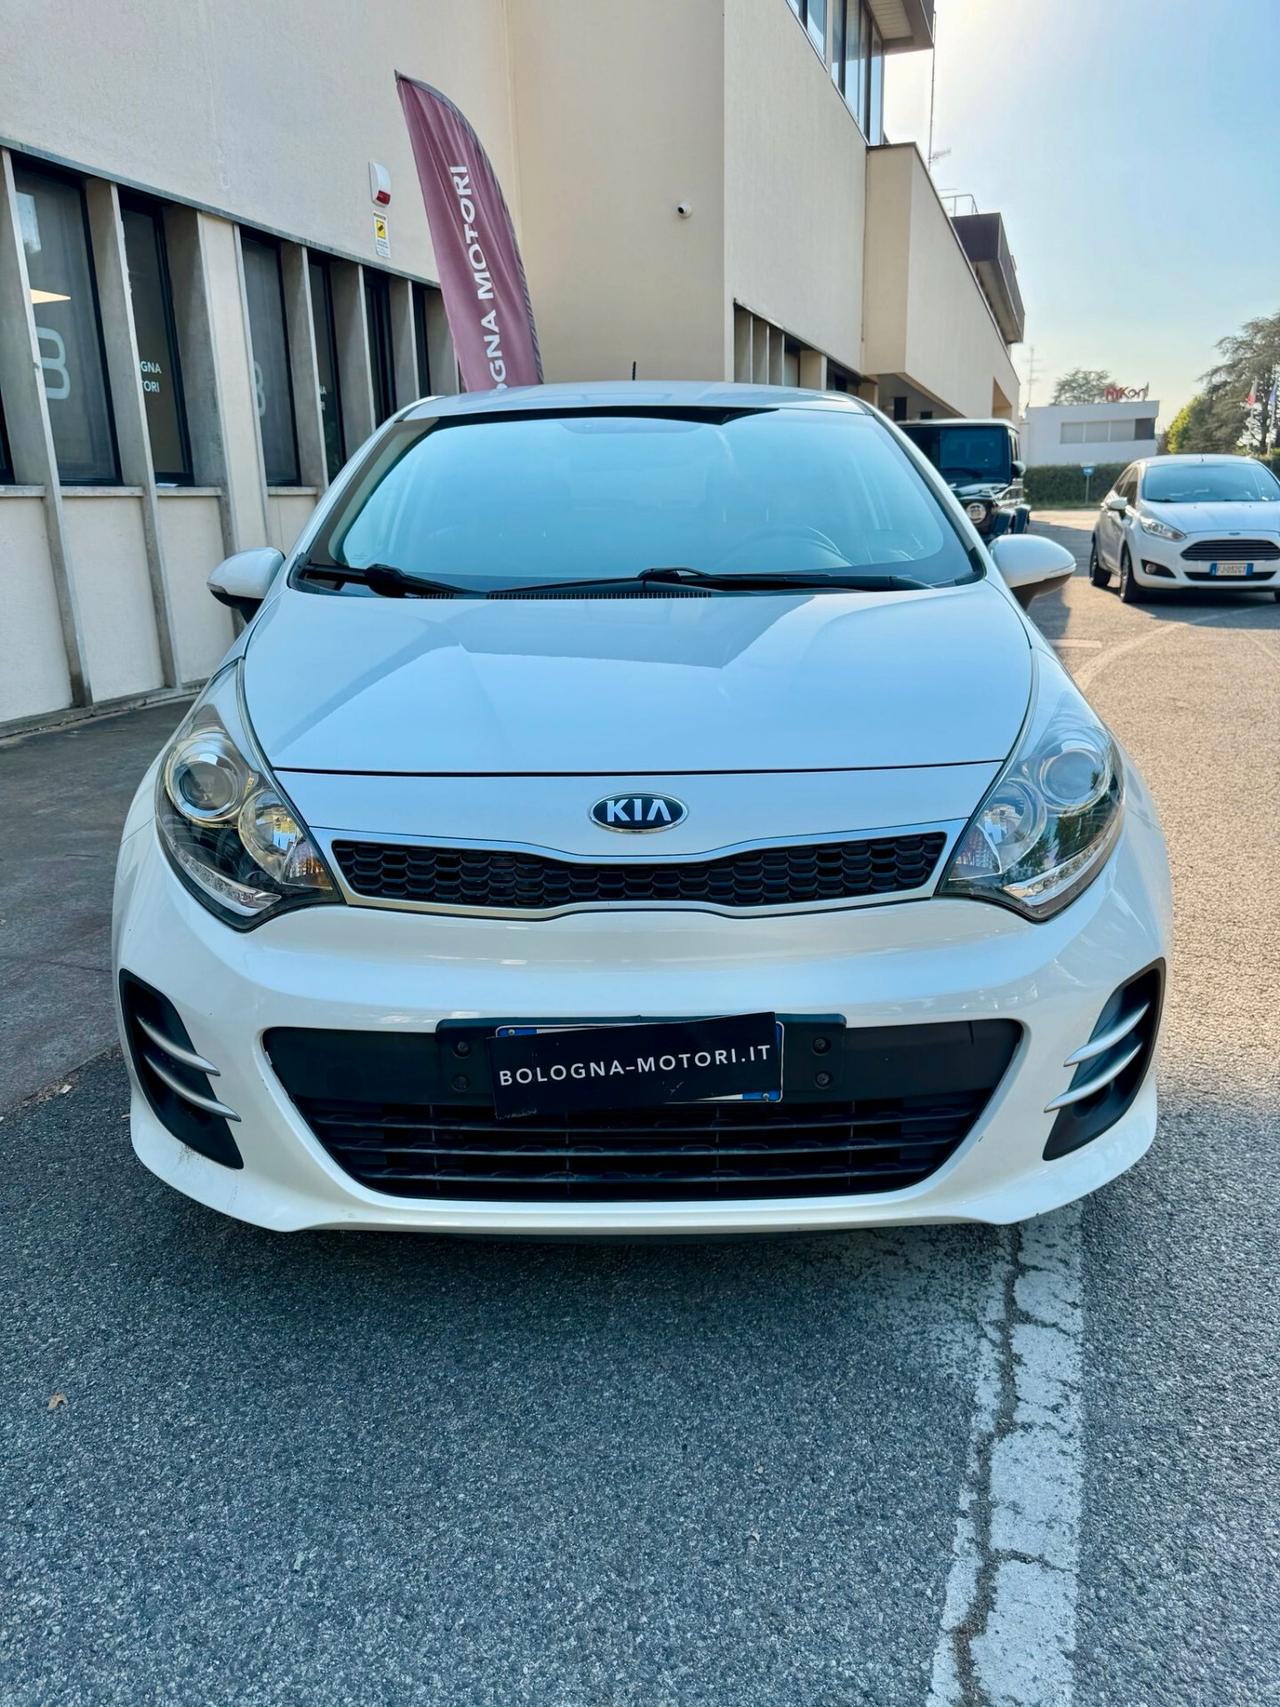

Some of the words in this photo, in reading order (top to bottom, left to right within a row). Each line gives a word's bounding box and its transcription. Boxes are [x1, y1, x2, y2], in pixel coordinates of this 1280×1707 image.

[450, 166, 494, 300] MOTORI
[606, 798, 672, 822] KIA
[499, 1045, 770, 1086] BOLOGNA-MOTORI.IT
